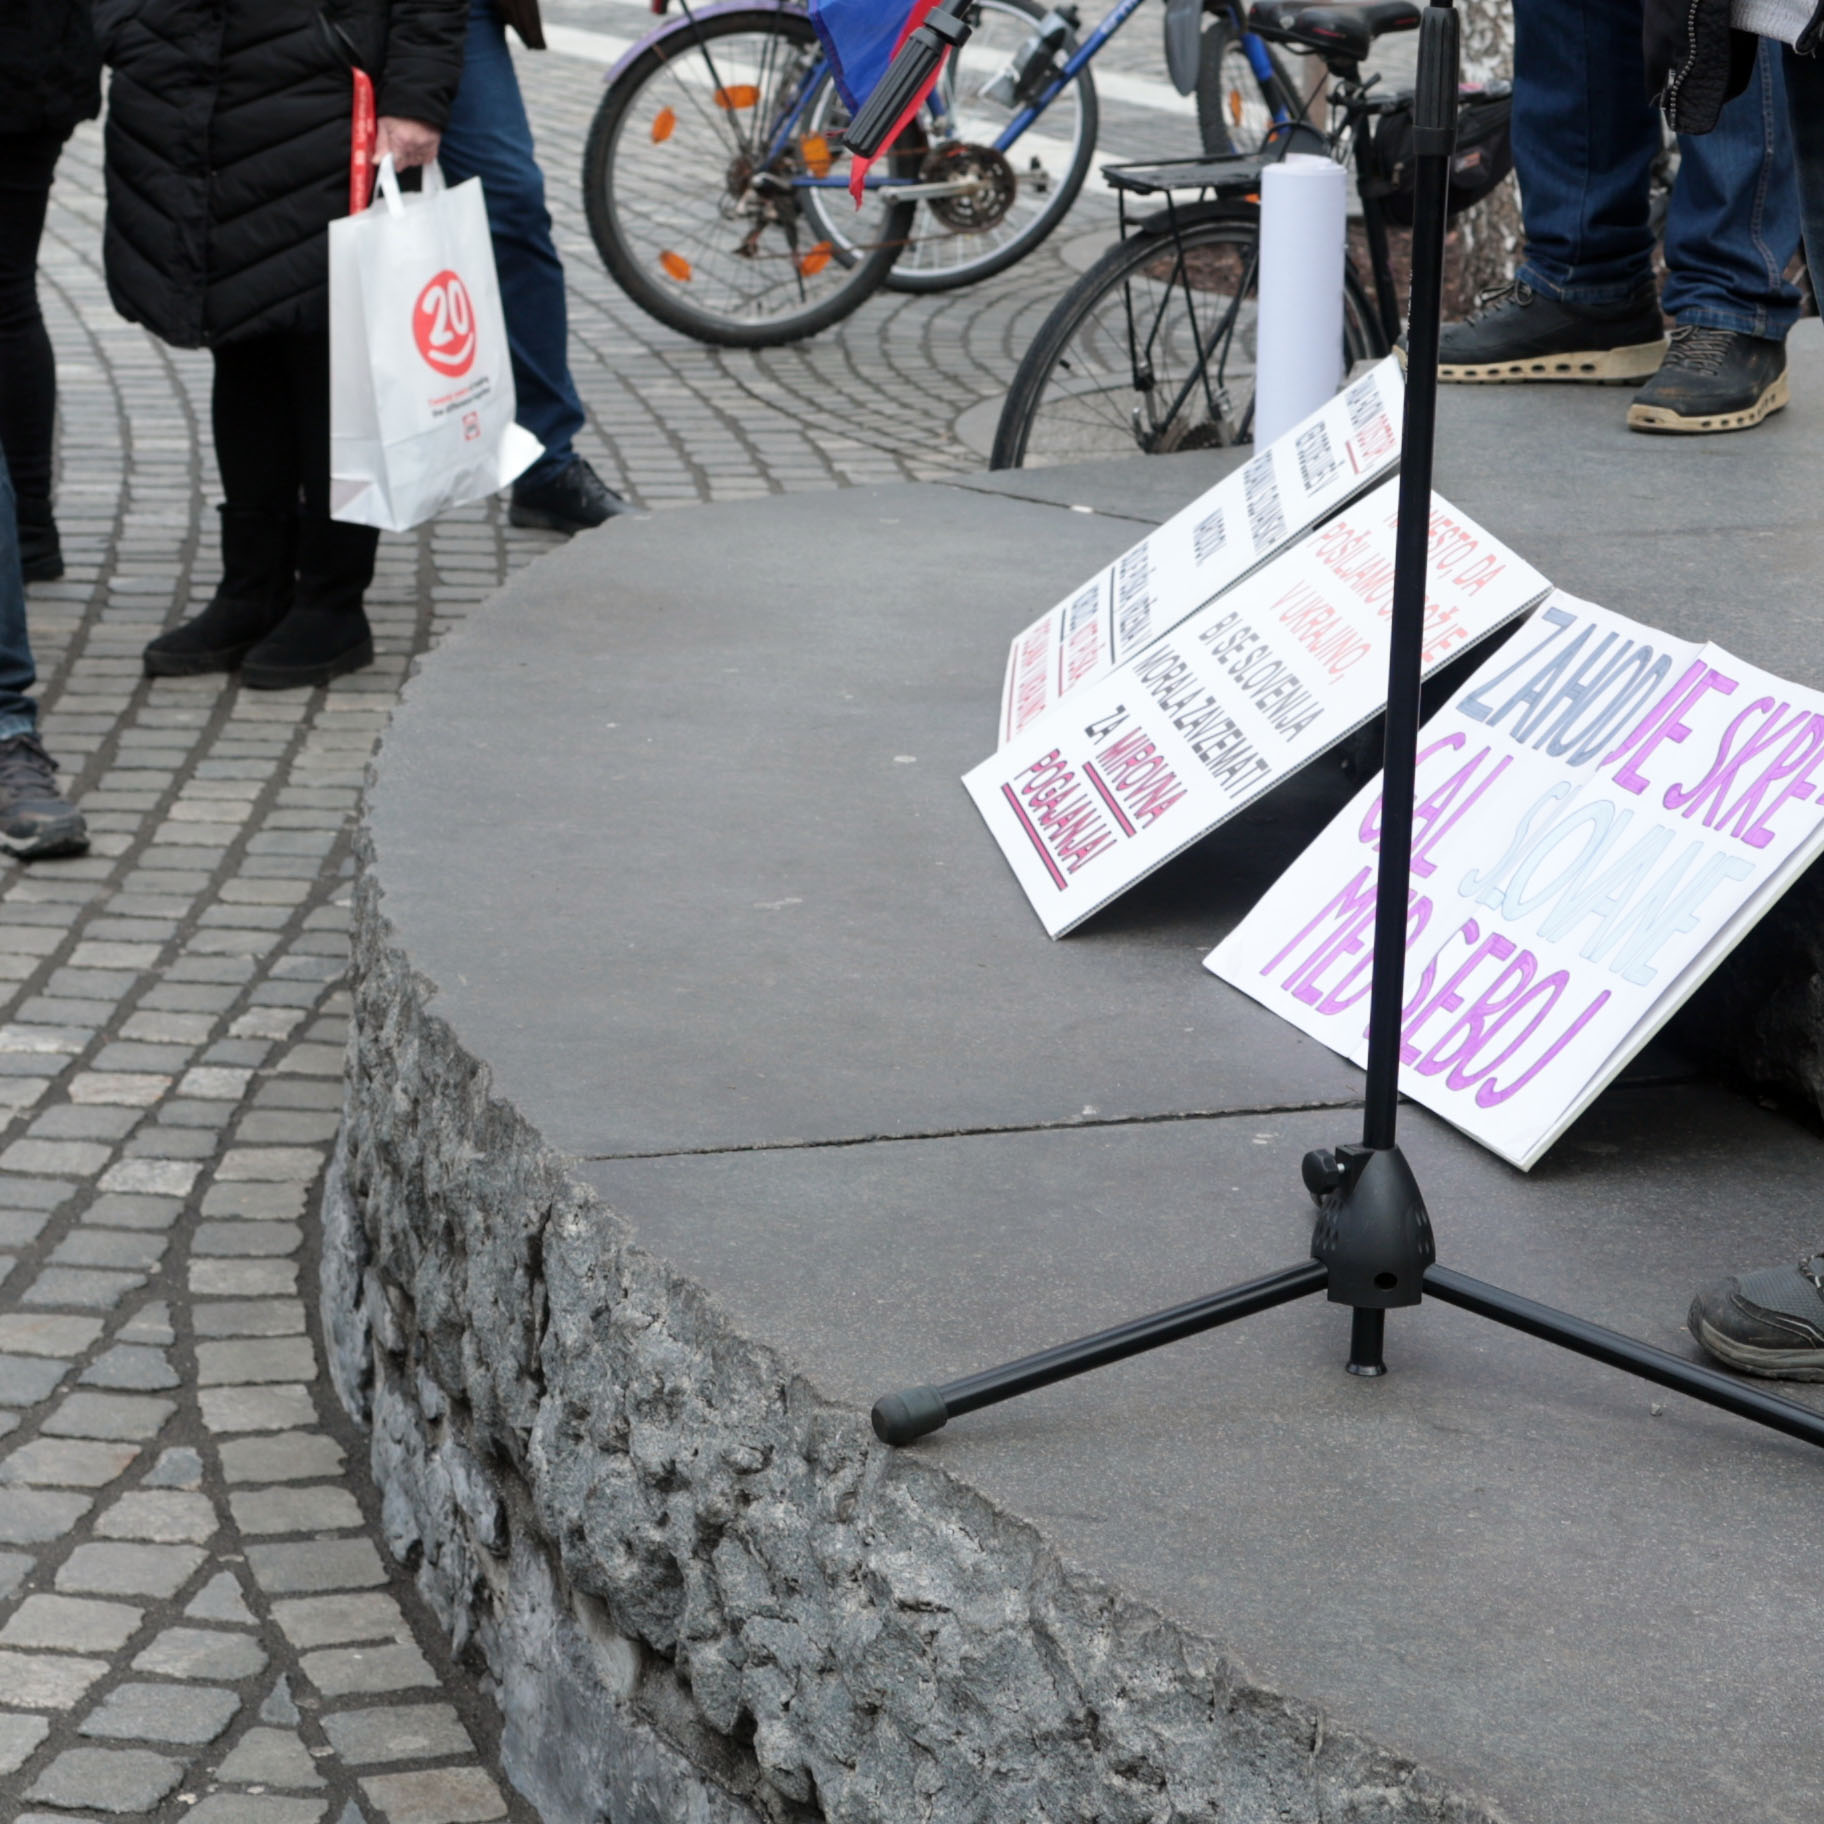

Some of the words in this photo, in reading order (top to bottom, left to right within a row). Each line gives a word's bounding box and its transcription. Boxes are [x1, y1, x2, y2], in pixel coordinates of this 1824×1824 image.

[422, 279, 470, 347] 20
[1267, 579, 1311, 613] V
[1305, 513, 1416, 608] POŠILJAMO
[1450, 553, 1509, 598] DA
[1197, 610, 1243, 646] BI
[1209, 623, 1260, 665] SE
[1271, 589, 1377, 686] UKRAJINO,
[1082, 702, 1132, 745] ZA
[1130, 642, 1207, 719] MORALA
[1171, 694, 1273, 800] ZAVZEMATI
[1225, 642, 1329, 743] SLOVENIJA
[1456, 608, 1673, 767] ZAHOD
[1597, 659, 1740, 795] JE
[1011, 746, 1119, 875] POGAJANJA!
[1094, 725, 1191, 829] MIROVNA
[1457, 780, 1756, 987] SLOVANE
